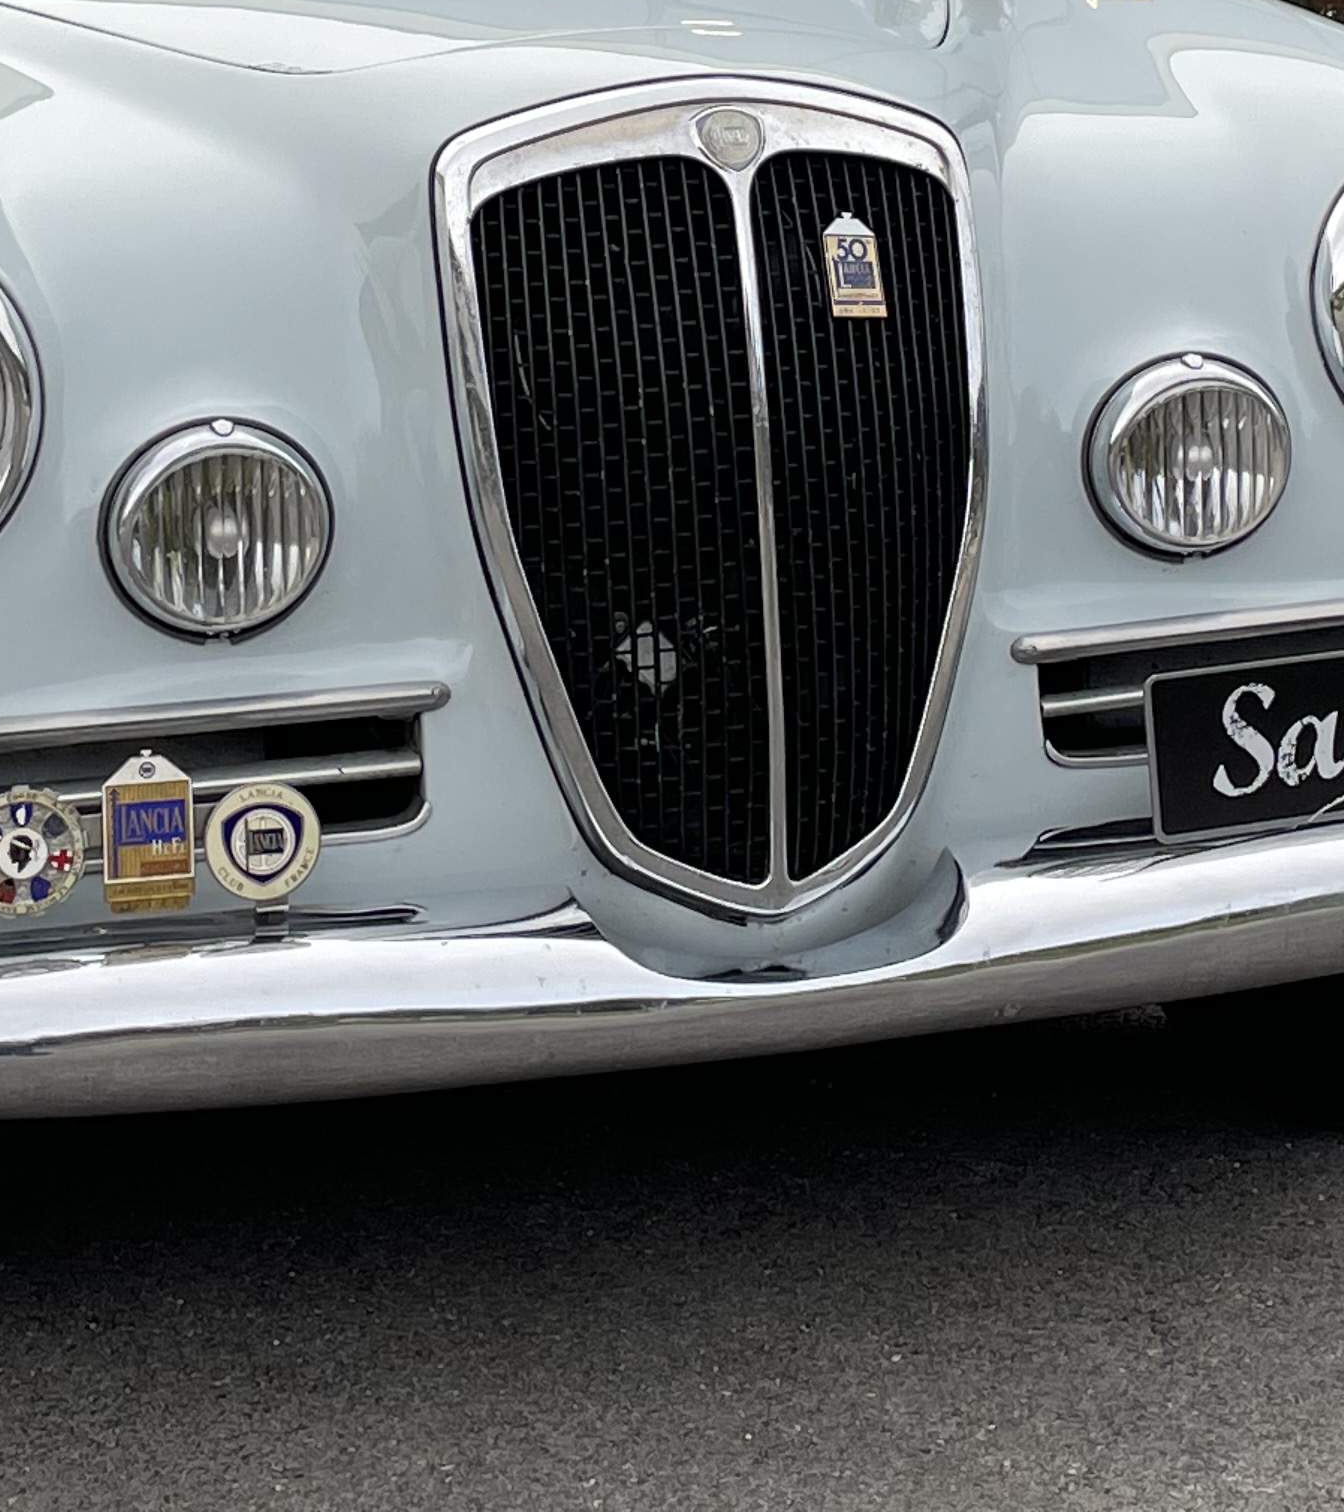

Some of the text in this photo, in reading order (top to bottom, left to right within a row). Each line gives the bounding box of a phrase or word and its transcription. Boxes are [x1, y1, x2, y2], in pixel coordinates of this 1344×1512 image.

[239, 787, 284, 802] LANCIA
[120, 805, 185, 843] LANCIA
[217, 866, 245, 892] CLUB
[284, 845, 315, 889] FRANCE
